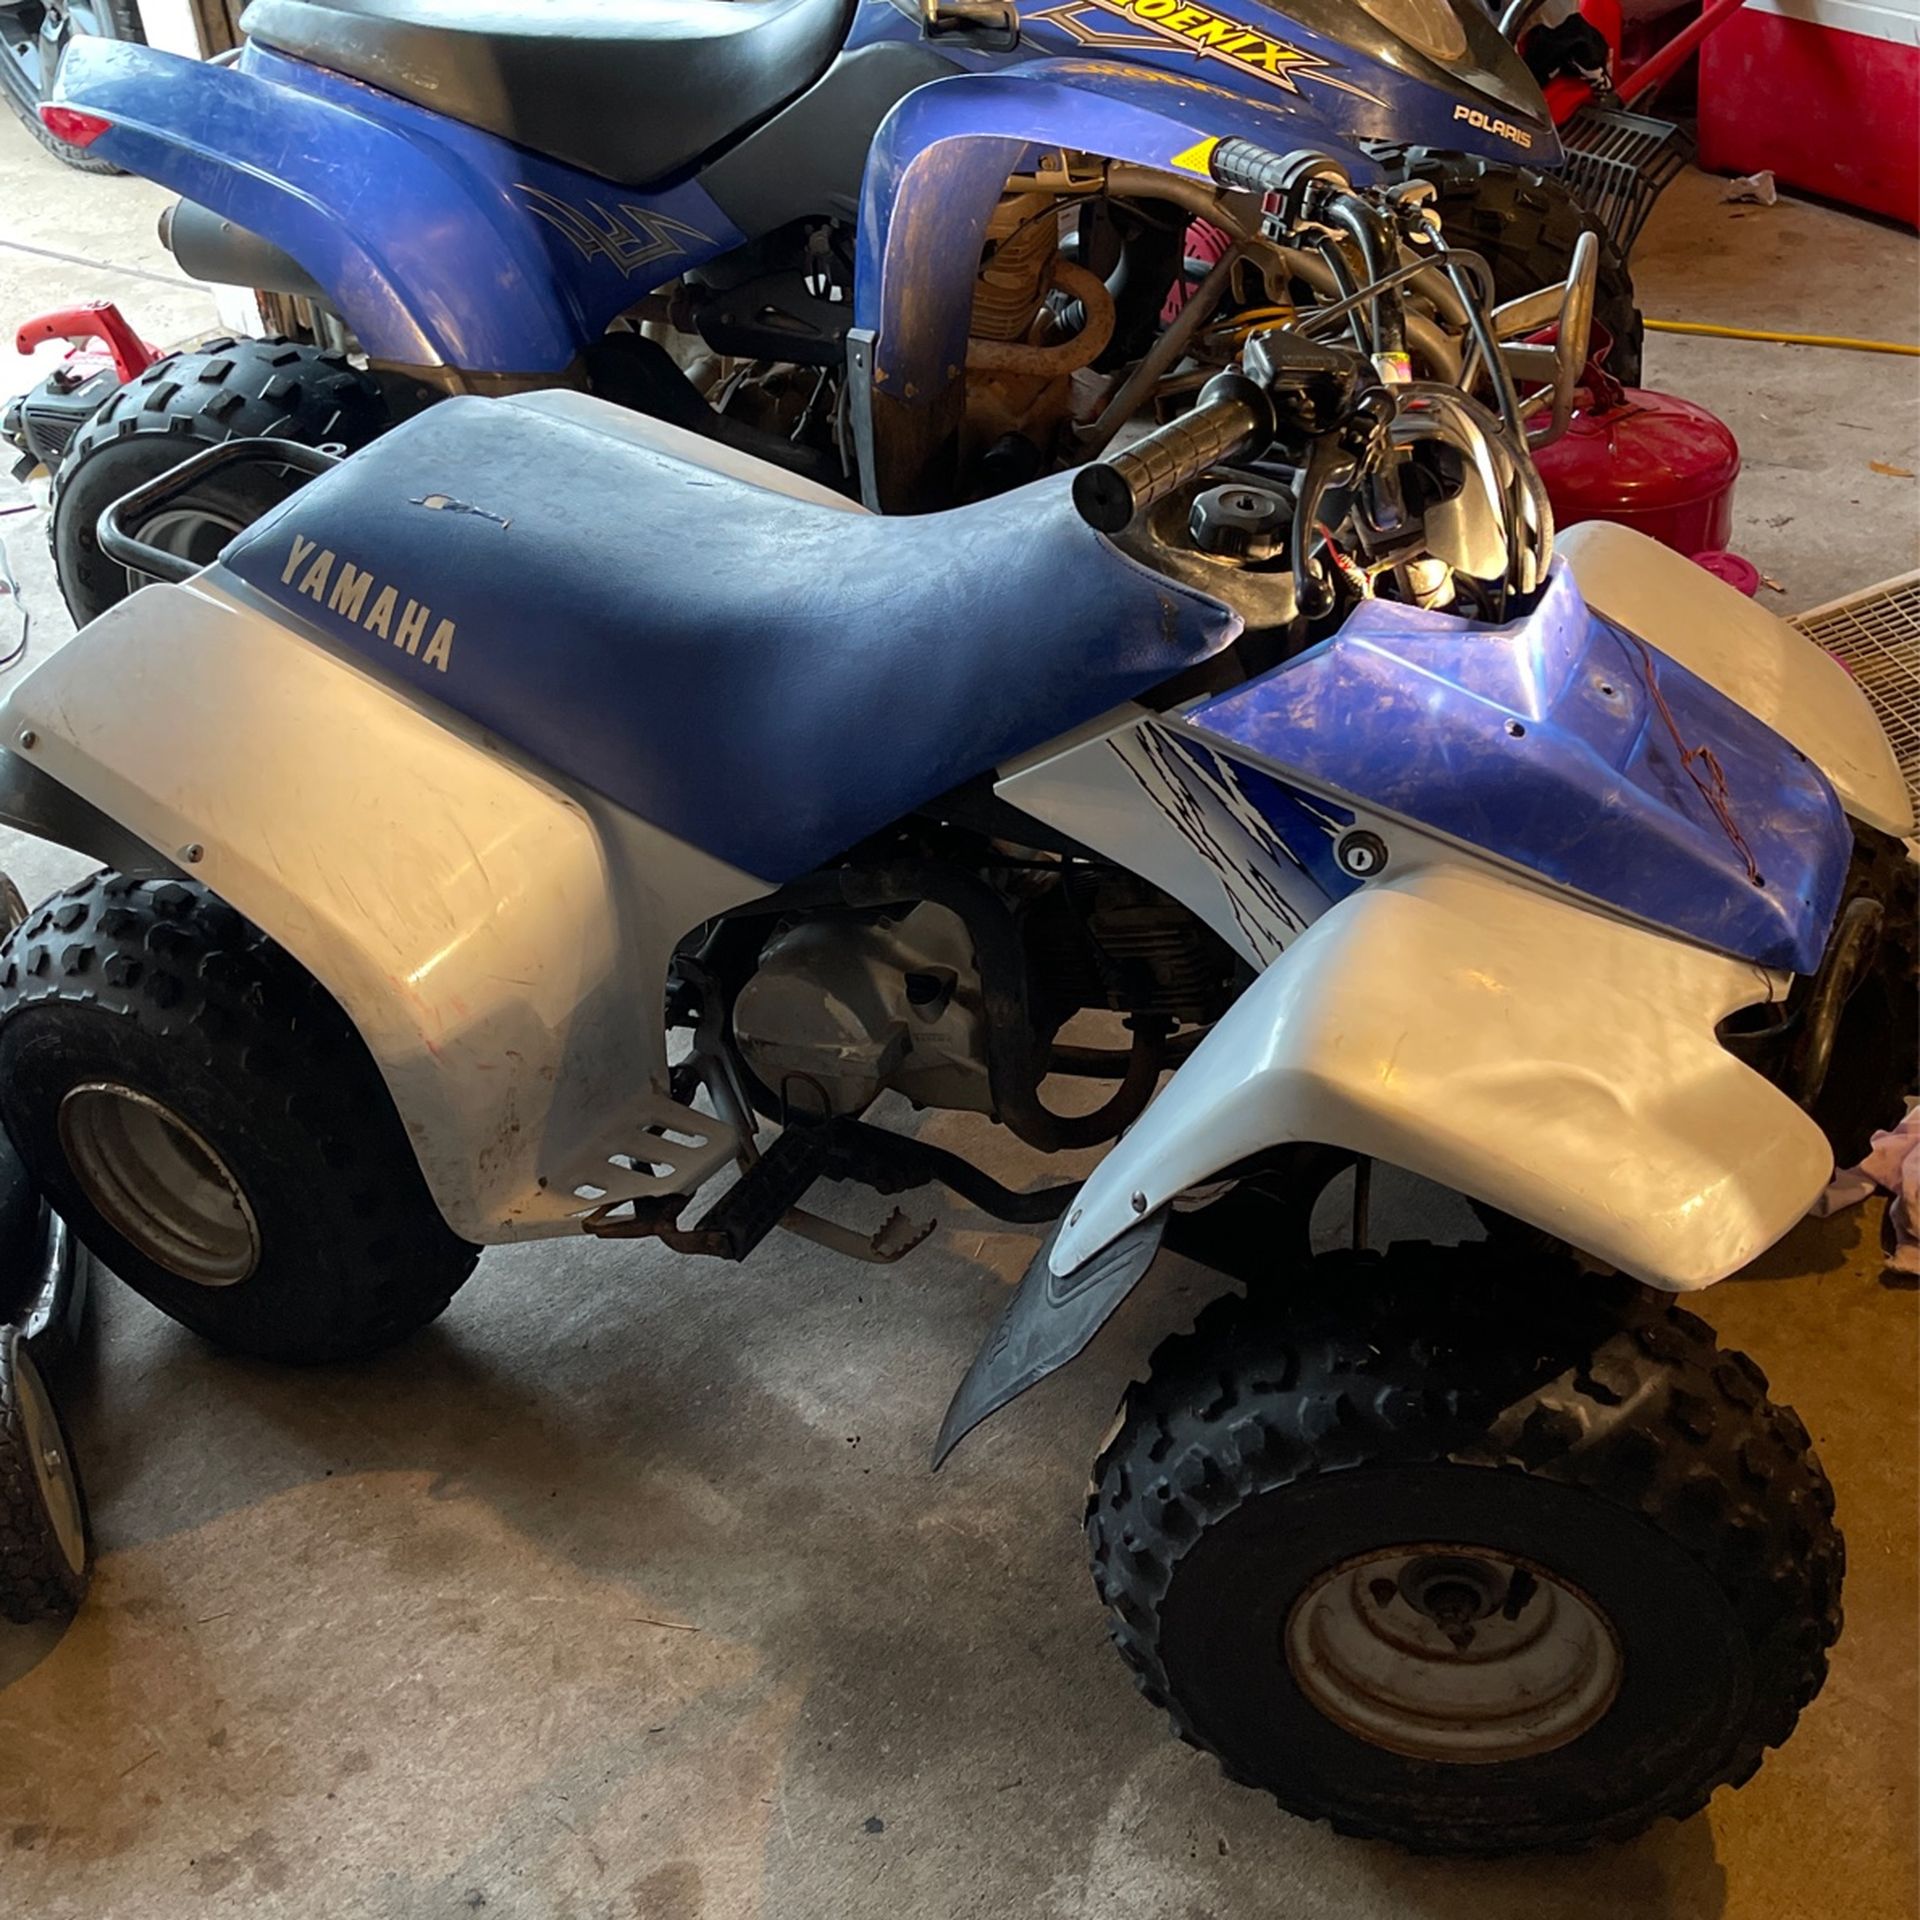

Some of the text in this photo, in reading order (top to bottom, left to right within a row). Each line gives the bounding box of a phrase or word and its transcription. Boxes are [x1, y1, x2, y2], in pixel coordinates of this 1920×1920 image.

[1109, 0, 1305, 74] OENIX
[1453, 105, 1532, 149] POLARIS
[281, 534, 456, 673] YAMAHA
